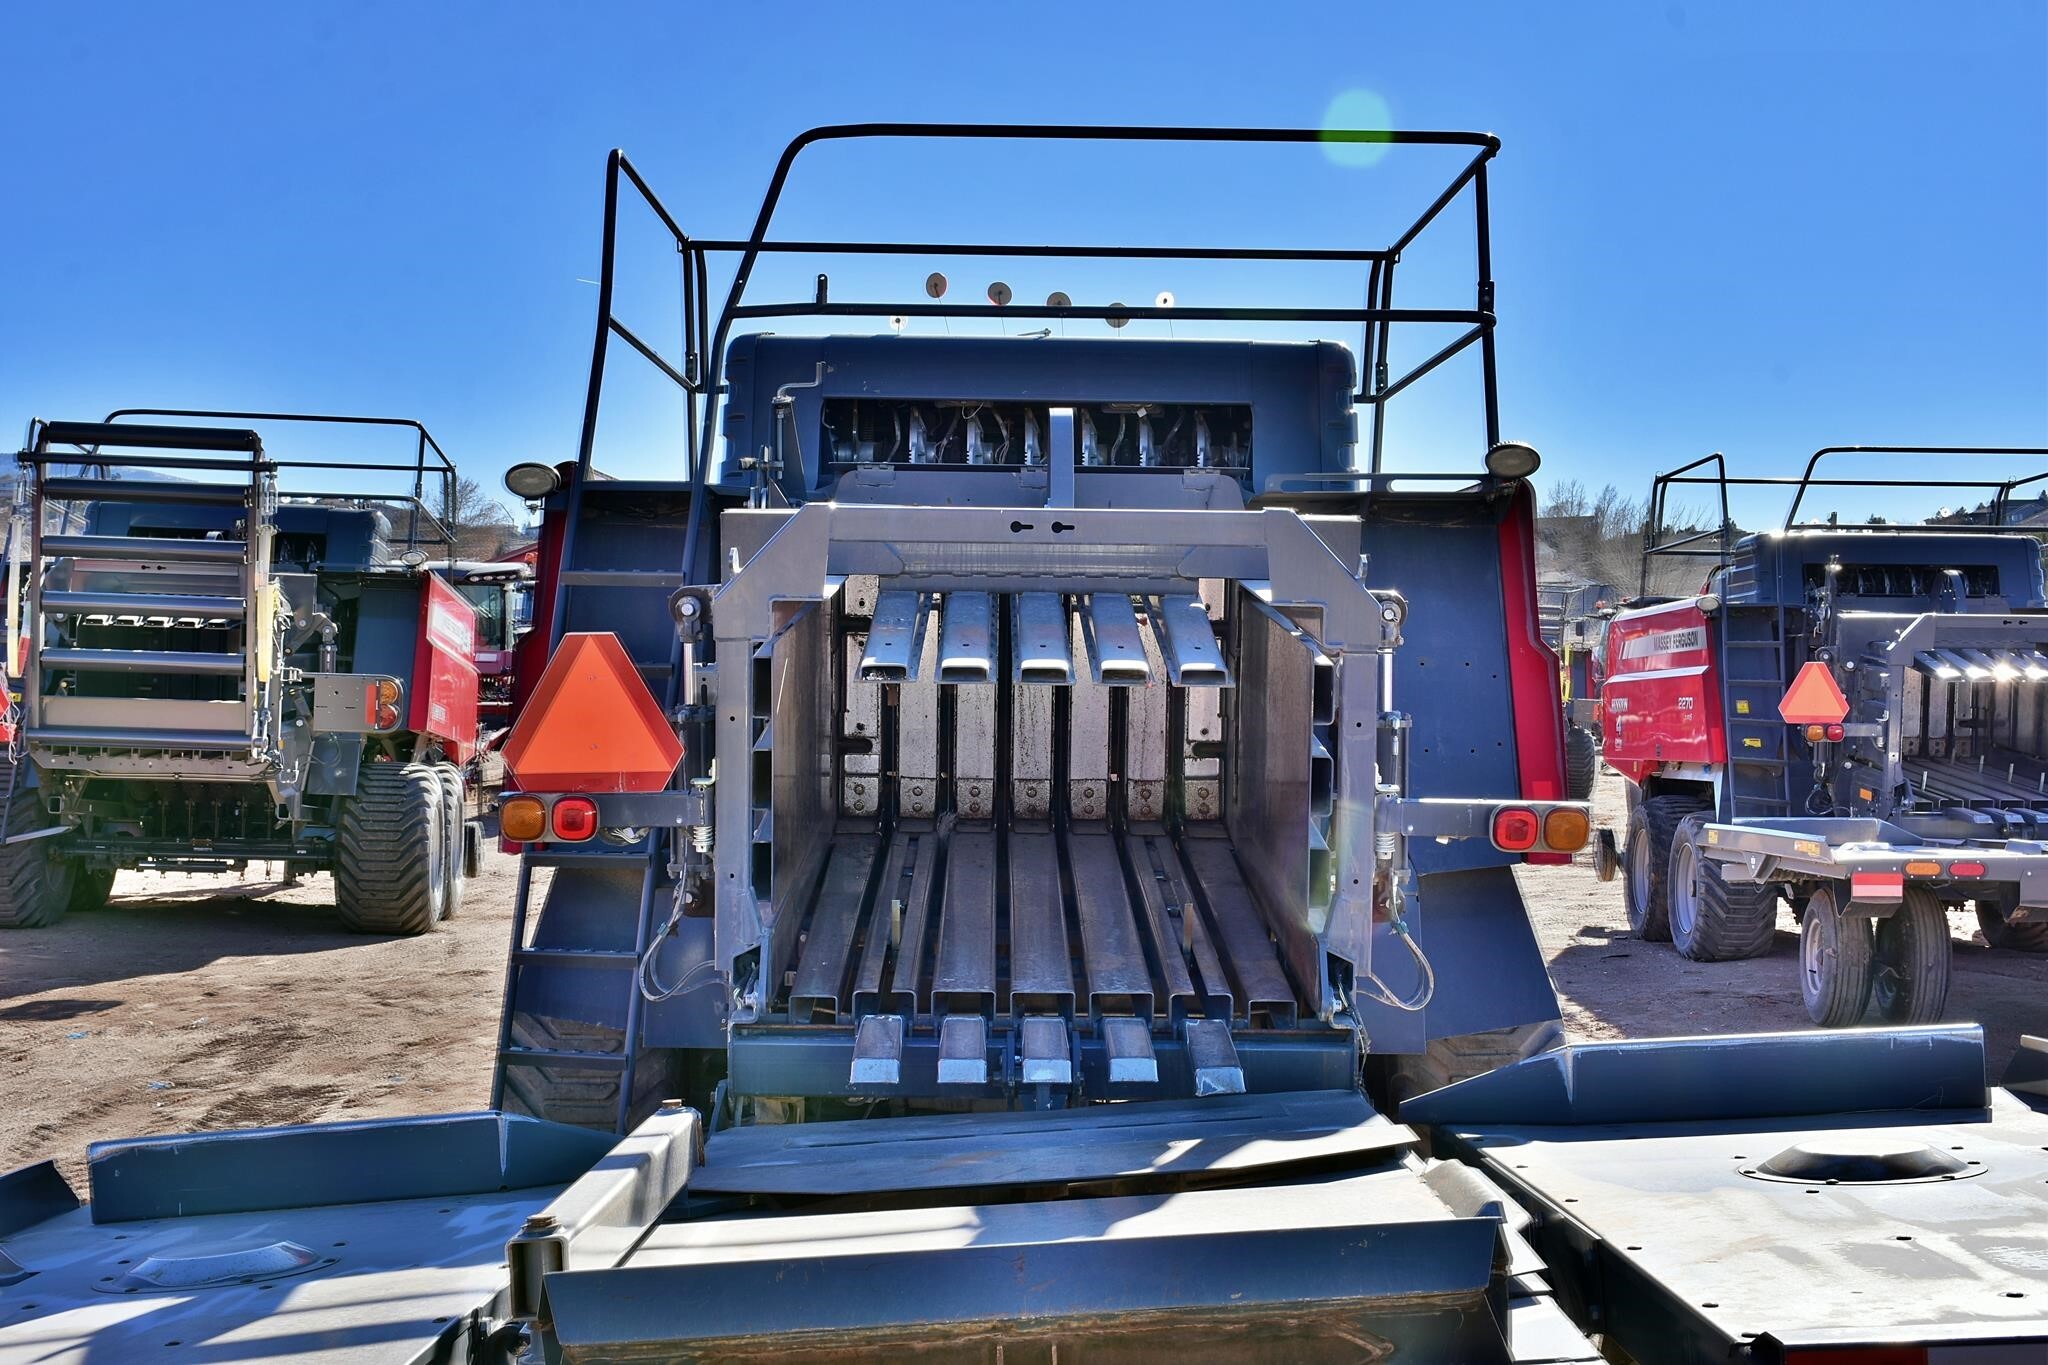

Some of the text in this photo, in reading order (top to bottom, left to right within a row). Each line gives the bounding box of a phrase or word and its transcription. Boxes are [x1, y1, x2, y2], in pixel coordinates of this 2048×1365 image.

[1653, 630, 1699, 651] MASSEY FERGUSON
[1678, 696, 1693, 710] 2270
